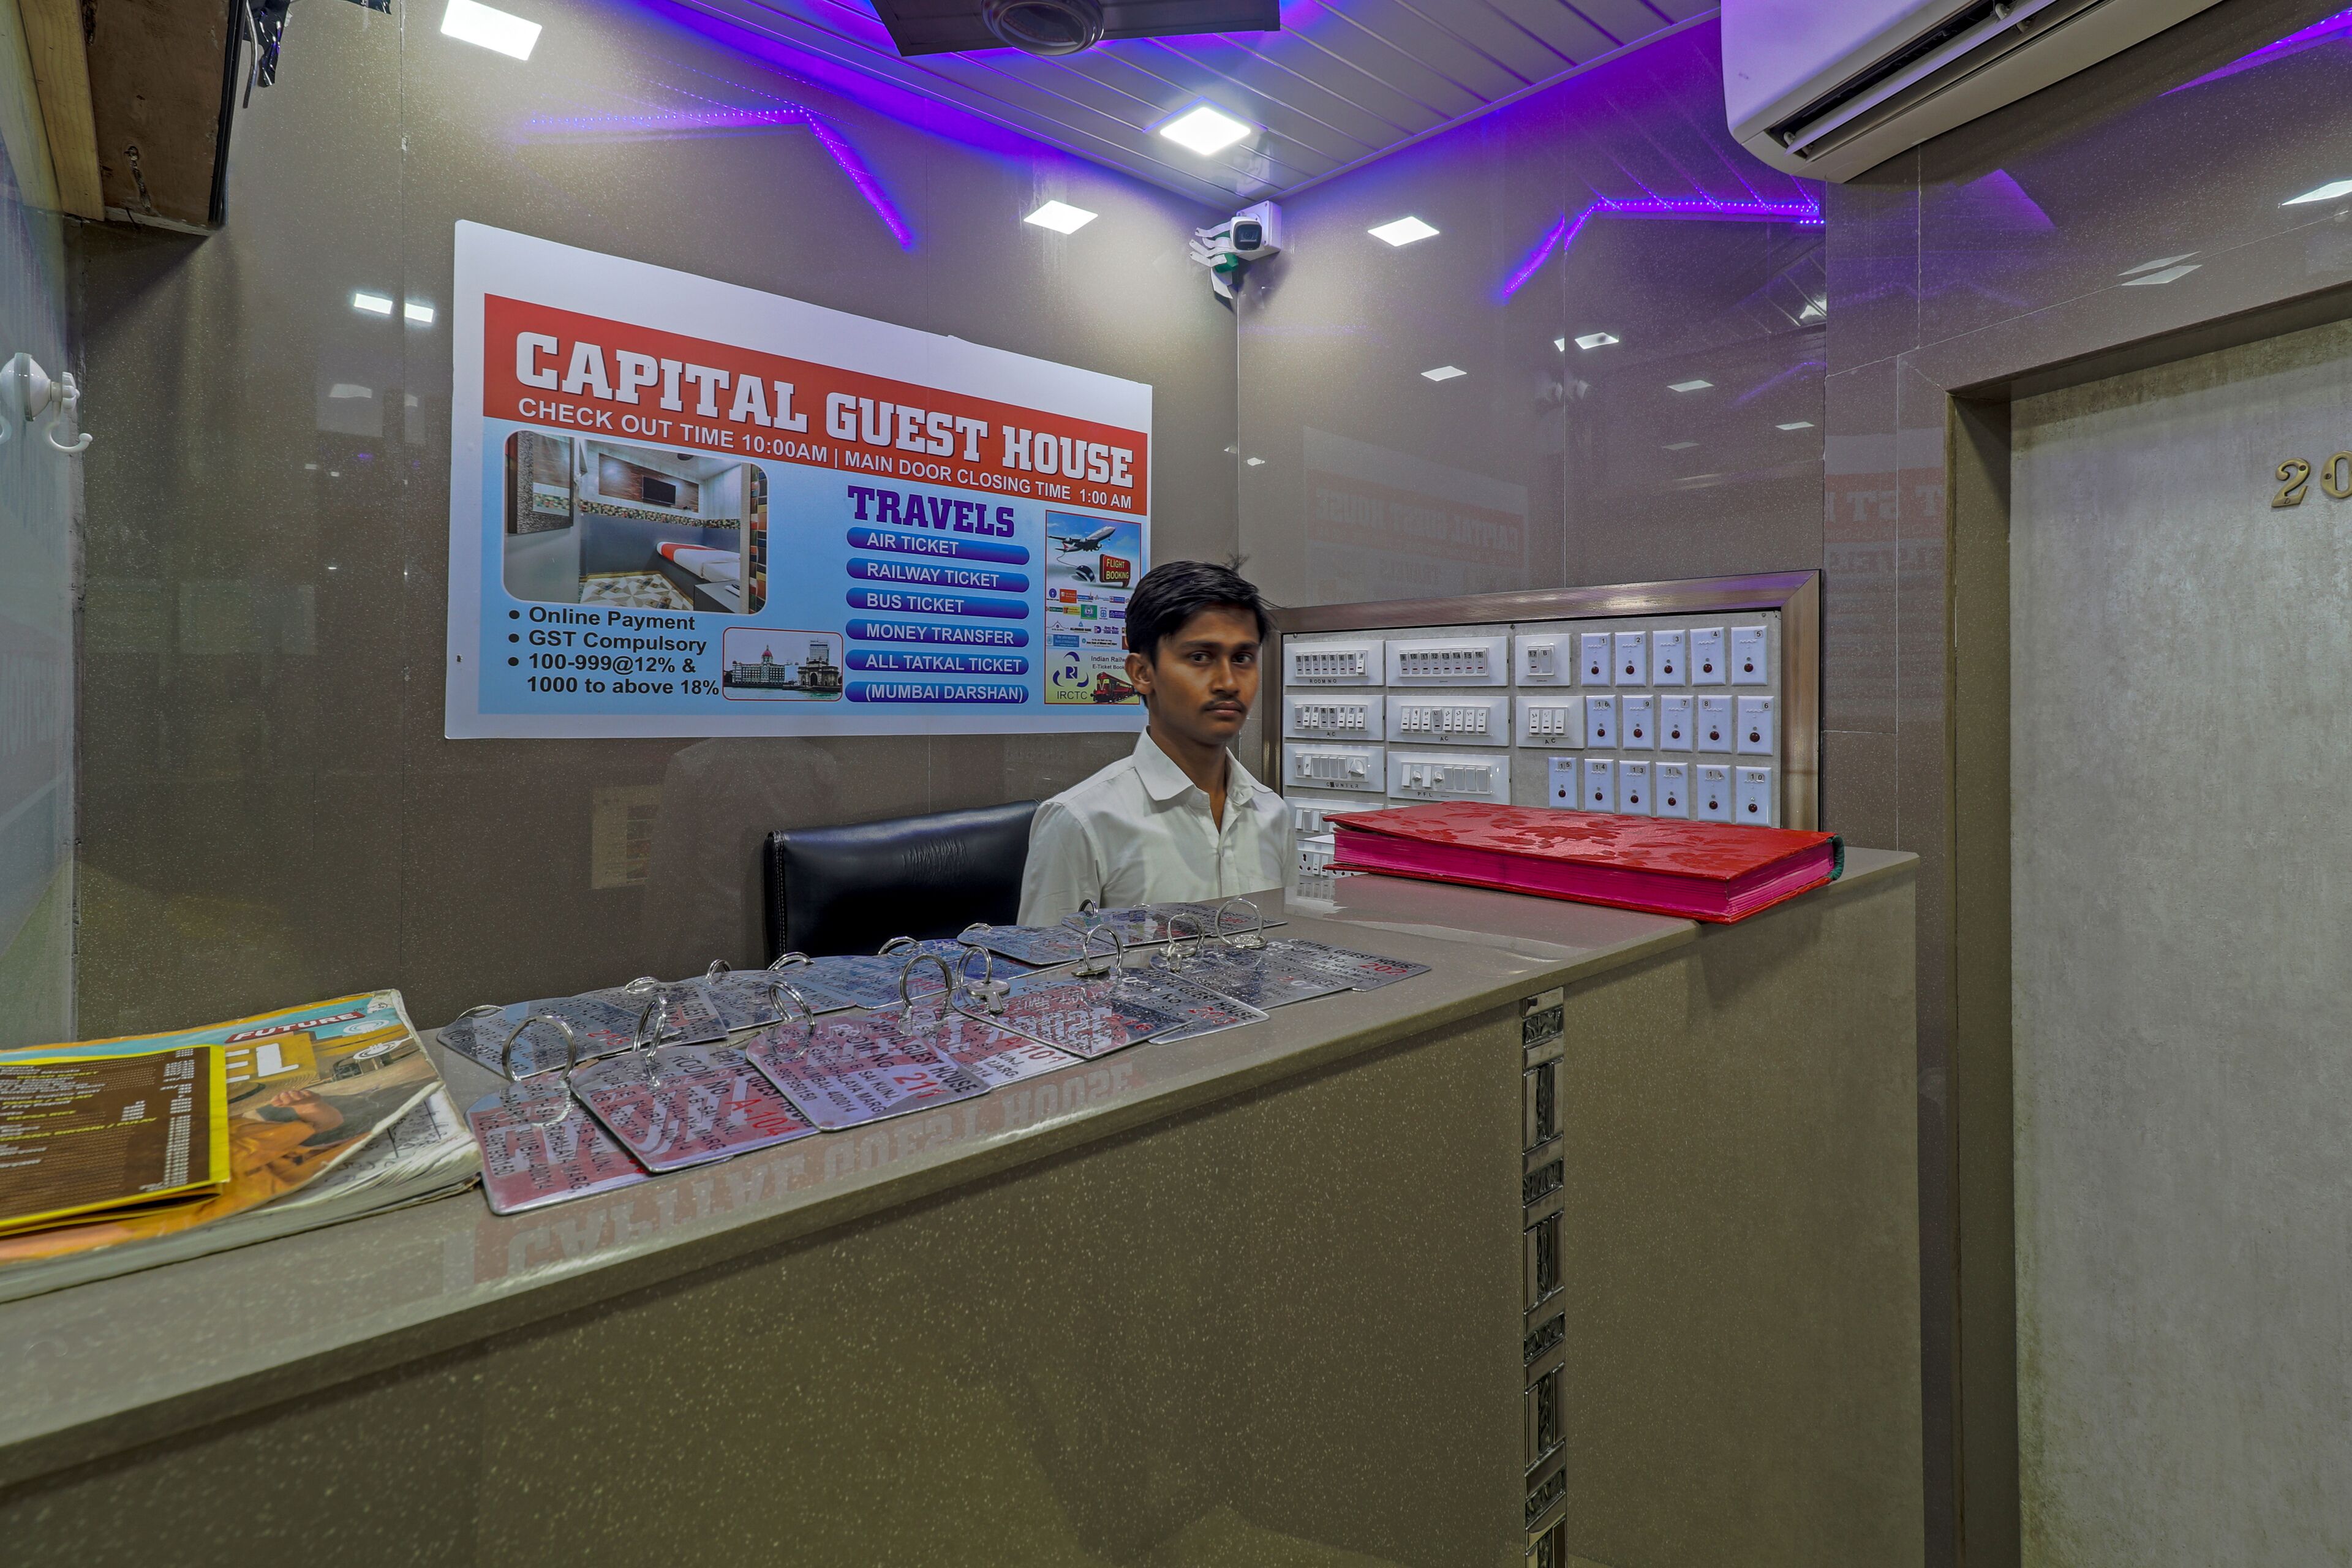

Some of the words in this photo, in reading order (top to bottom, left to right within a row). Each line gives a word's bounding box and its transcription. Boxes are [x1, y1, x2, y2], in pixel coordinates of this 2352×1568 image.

[516, 331, 807, 434] CAPITAL
[826, 392, 988, 462] GUEST
[1002, 424, 1133, 489] HOUSE
[518, 397, 614, 430] CHECK
[621, 413, 673, 439] OUT
[680, 423, 734, 449] TIME
[742, 434, 827, 463] 10:00AM
[845, 450, 893, 473] MAIN
[899, 459, 952, 482] DOOR
[956, 467, 1031, 493] CLOSING
[1035, 480, 1072, 500] TIME
[1079, 488, 1107, 505] 1:00
[1110, 492, 1132, 509] AM
[848, 484, 1015, 538] TRAVELS
[866, 532, 897, 548] AIR
[901, 535, 959, 555] TICKET
[867, 562, 941, 582] RAILWAY
[944, 569, 1000, 587] TICKET
[1106, 558, 1125, 569] FLIGHT
[1106, 570, 1129, 580] BOOKING
[866, 592, 902, 609] BUS
[907, 595, 965, 612] TICKET
[529, 606, 601, 626] Online
[608, 611, 695, 631] Payment
[529, 630, 577, 647] GST
[583, 632, 707, 655] Compulsory
[866, 623, 927, 641] MONEY
[932, 627, 1014, 645] TRANSFER
[529, 653, 675, 675] 100-999@12%
[682, 658, 696, 673] &
[865, 654, 899, 669] ALL
[903, 655, 965, 671] TATKAL
[968, 657, 1022, 673] TICKET
[527, 676, 578, 693] 1000
[584, 677, 606, 693] to
[612, 678, 673, 694] above
[680, 679, 719, 696] 18%
[865, 684, 939, 702] (MUMBAI
[944, 685, 1023, 703] DARSHAN)
[1057, 691, 1087, 699] IRCTC
[1332, 949, 1376, 960] GUEST
[1359, 962, 1409, 975] 202
[1175, 986, 1223, 1002] GUEST
[1209, 1001, 1262, 1020] HOUSE
[235, 1012, 358, 1041] FUTURE
[585, 1028, 631, 1047] 215
[708, 1048, 760, 1077] CAPITAL
[865, 1019, 911, 1045] CAPITAL
[898, 1043, 945, 1068] GUEST
[930, 1065, 979, 1093] HOUSE
[666, 1051, 719, 1082] ROOM
[701, 1079, 736, 1099] No.
[805, 1047, 870, 1093] SANGRAHALAYA
[866, 1052, 904, 1072] No.
[891, 1070, 949, 1099] 211
[772, 1067, 820, 1102] 9967950150
[855, 1069, 880, 1082] SAI
[869, 1080, 904, 1101] KUNJ,
[696, 1104, 721, 1117] SAI
[824, 1090, 861, 1113] 400014
[581, 1135, 603, 1152] SAI
